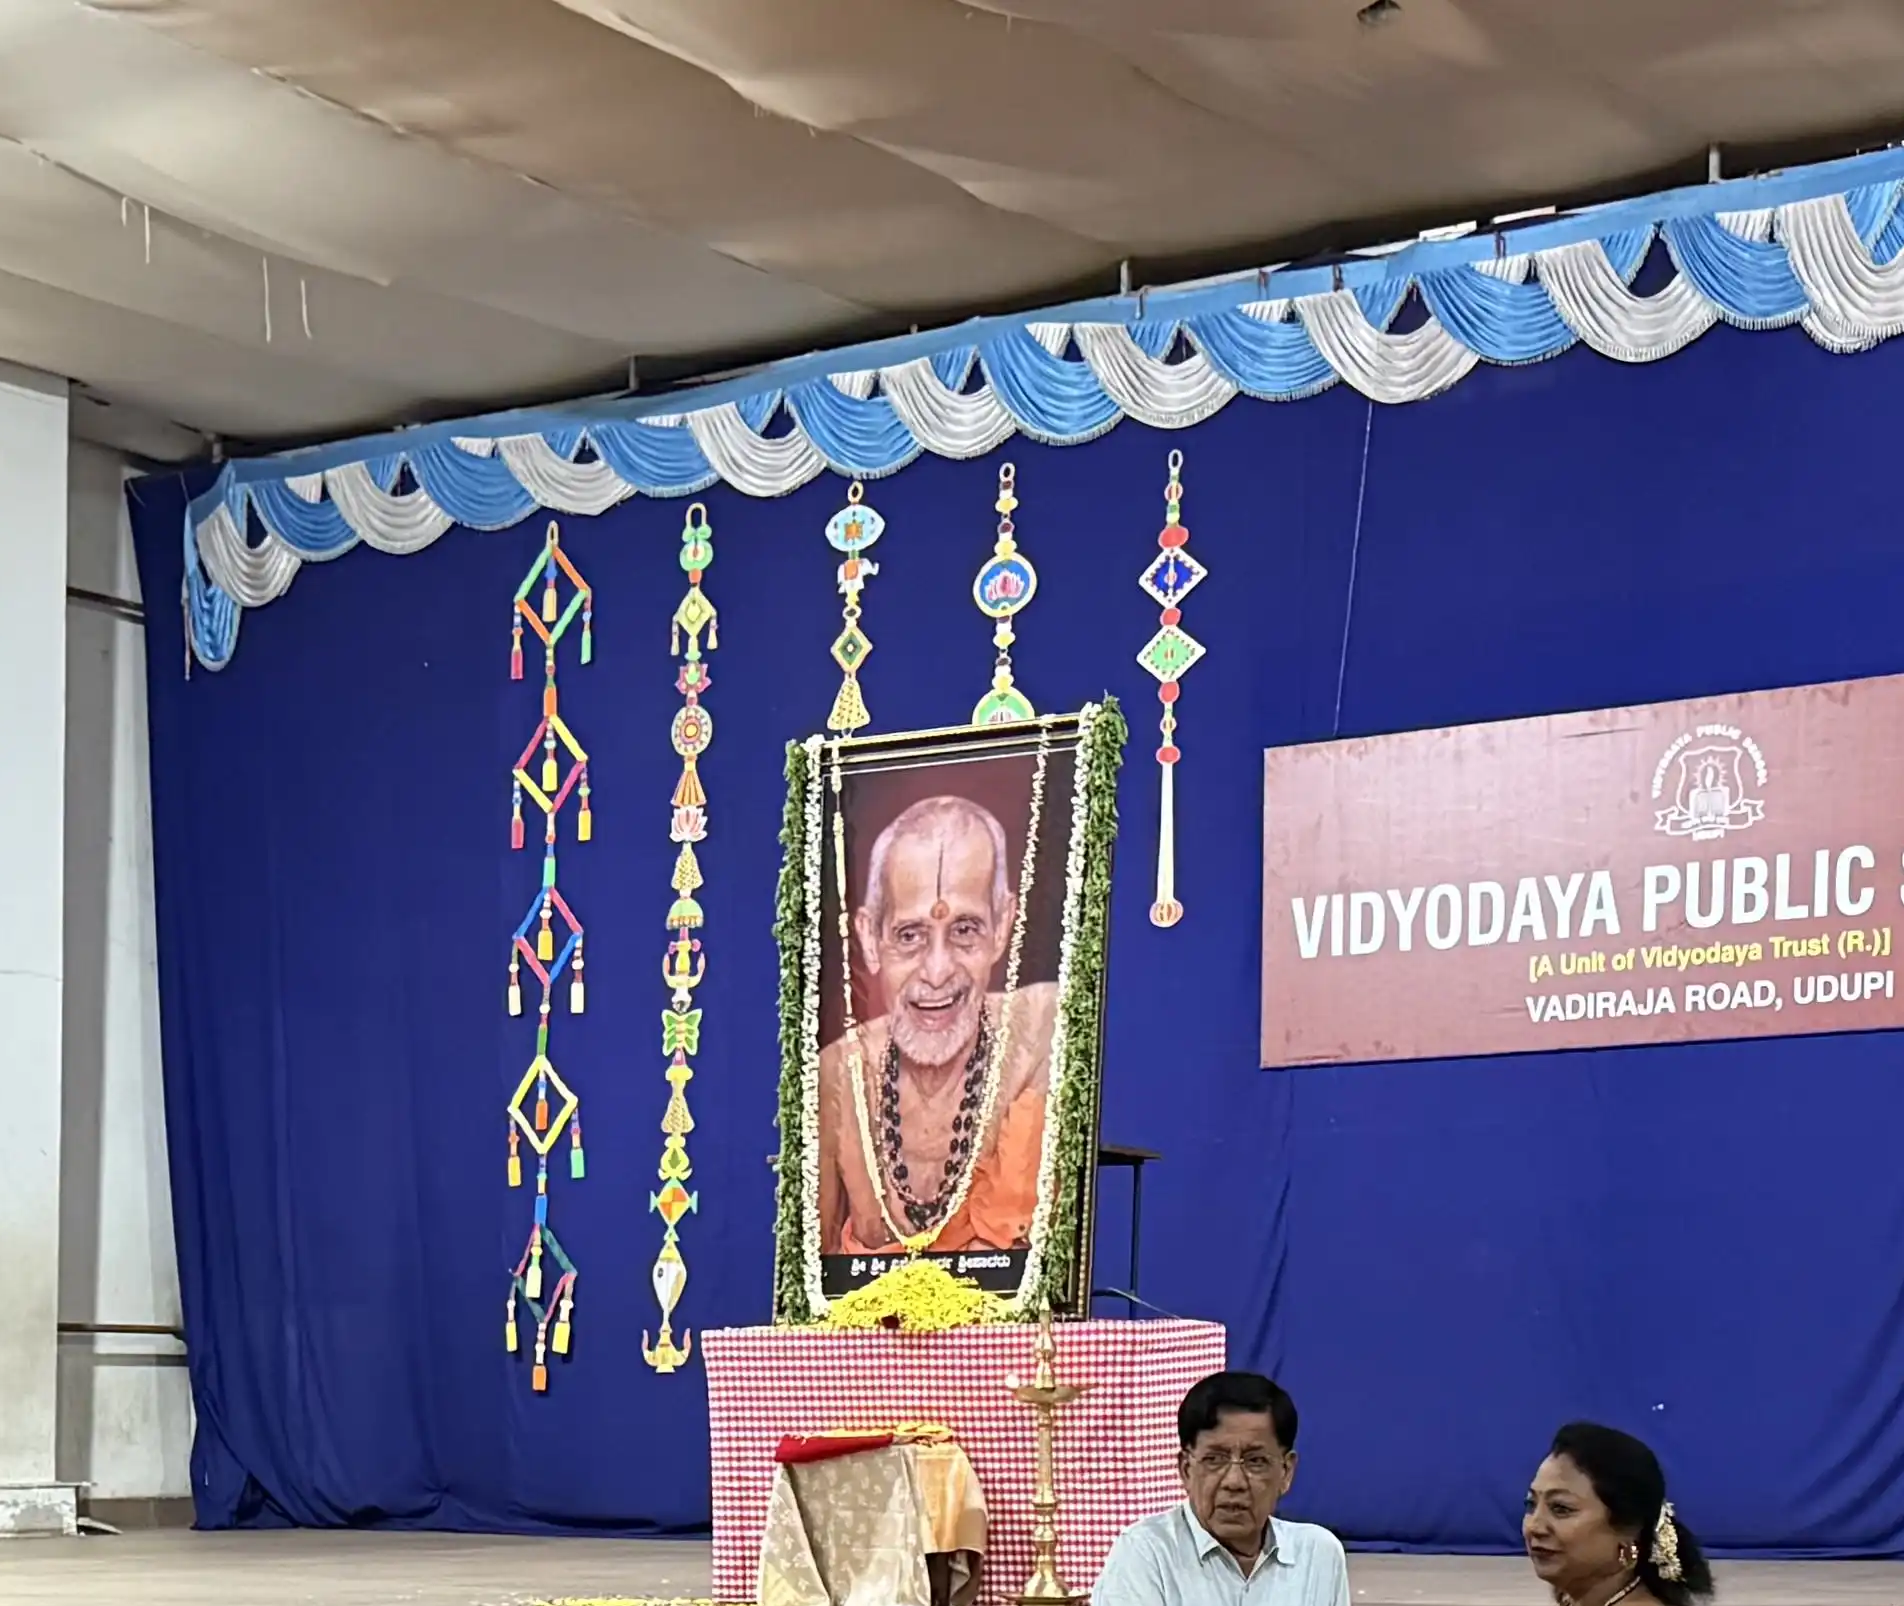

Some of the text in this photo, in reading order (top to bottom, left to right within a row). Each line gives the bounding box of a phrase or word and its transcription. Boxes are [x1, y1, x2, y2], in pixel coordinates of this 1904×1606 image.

[1291, 870, 1621, 960] VIDYODAYA
[1642, 845, 1876, 933] PUBLIC
[1559, 950, 1607, 976] Unit
[1611, 947, 1636, 972] of
[1640, 940, 1763, 972] Vidyodaya
[1768, 932, 1830, 960] Trust
[1837, 926, 1892, 959] (R.)]
[1525, 970, 1894, 1023] VADIRAJA ROAD, UDUPI
